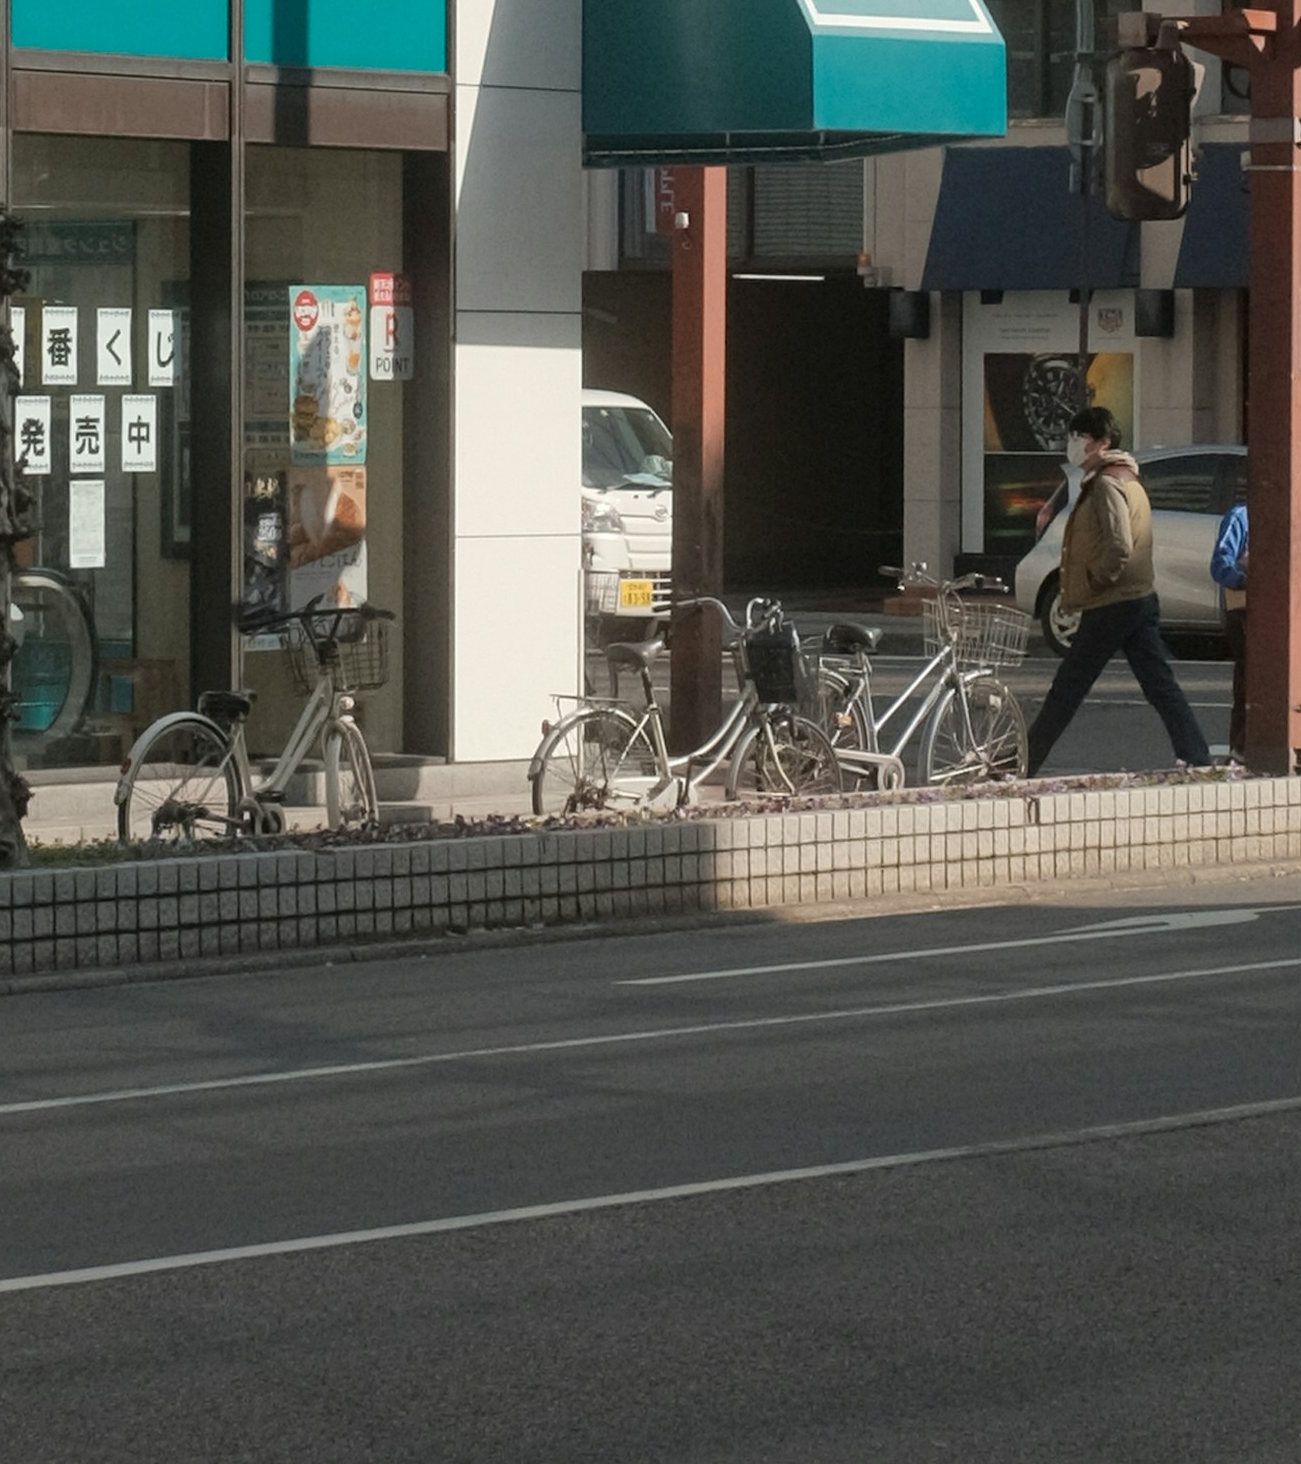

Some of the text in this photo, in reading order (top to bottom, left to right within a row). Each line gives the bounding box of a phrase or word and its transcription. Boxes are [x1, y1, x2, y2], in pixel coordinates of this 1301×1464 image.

[15, 328, 176, 369] 番くじ
[375, 357, 410, 374] POINT
[20, 415, 151, 457] 発売中
